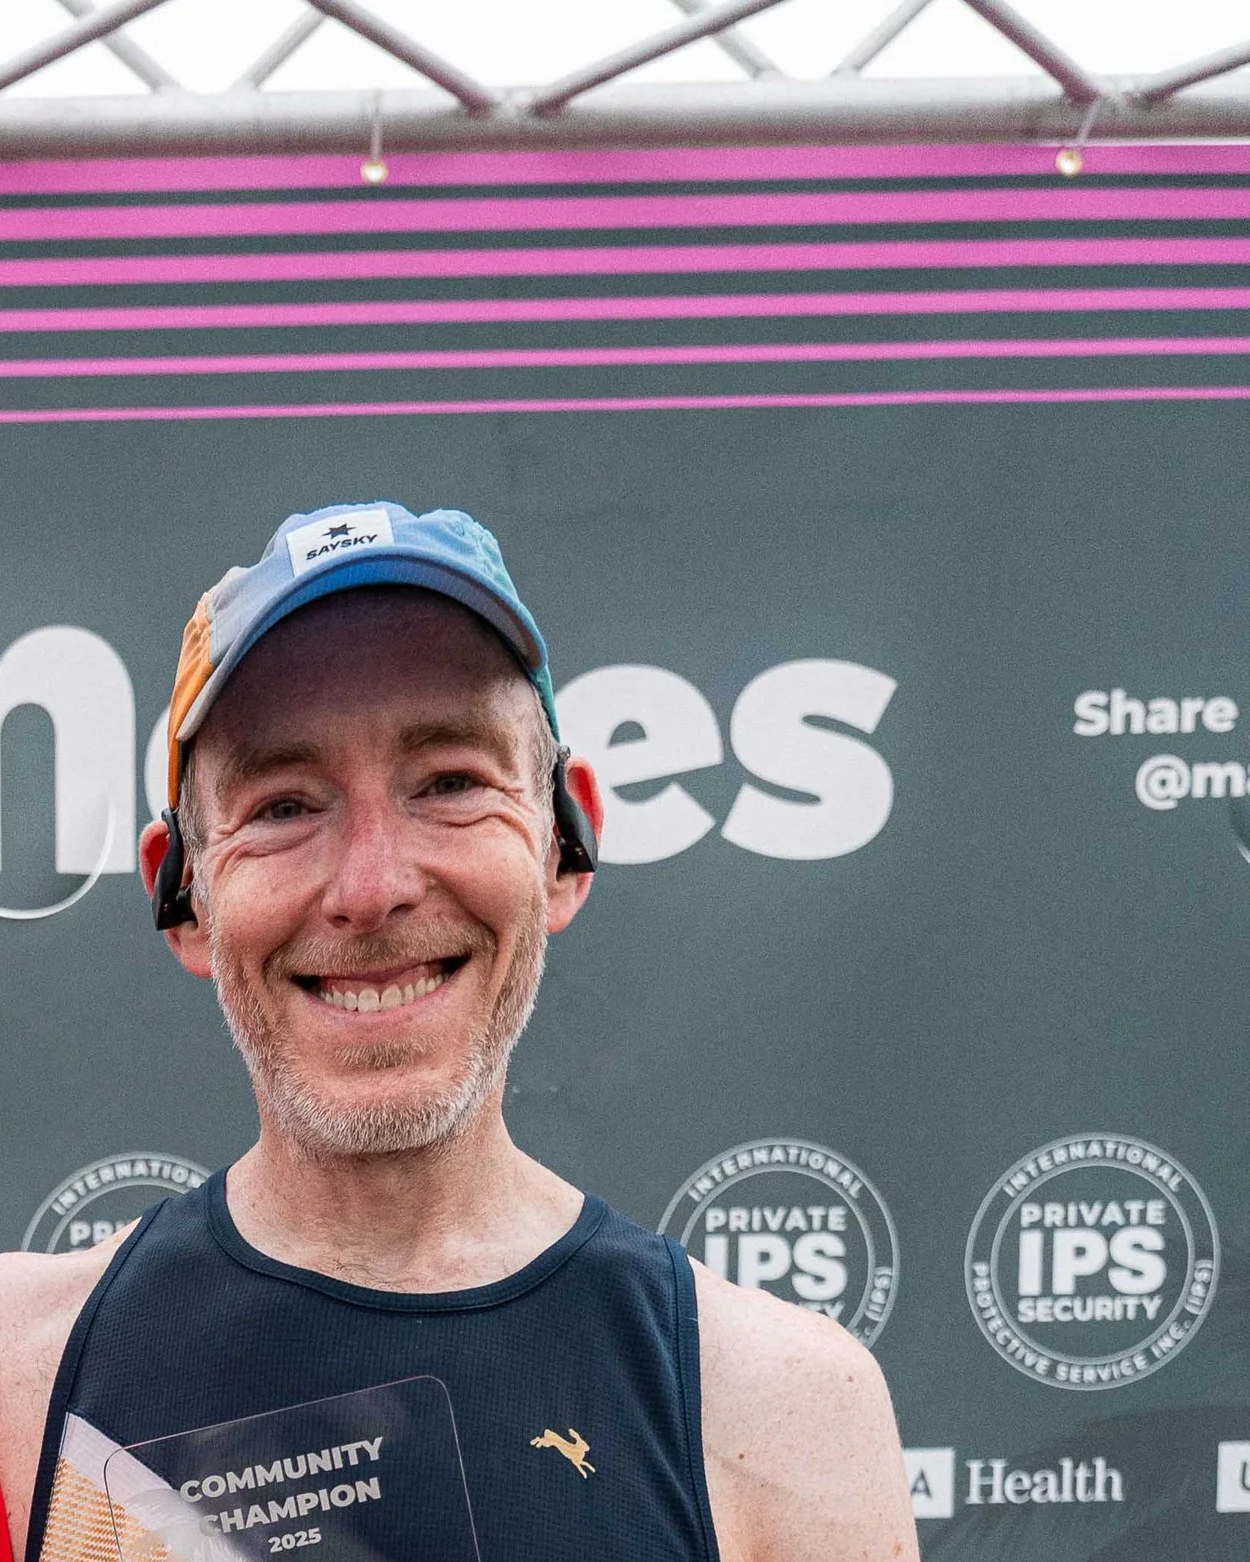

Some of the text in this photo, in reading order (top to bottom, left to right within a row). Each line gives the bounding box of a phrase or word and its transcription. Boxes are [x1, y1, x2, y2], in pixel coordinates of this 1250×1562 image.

[306, 533, 378, 561] SAYSKY
[1073, 690, 1237, 737] Share
[687, 1146, 863, 1202] INTERNATIONAL
[1002, 1141, 1184, 1197] INTERNATIONAL
[705, 1206, 847, 1232] PRIVATE
[1020, 1200, 1167, 1228] PRIVATE
[704, 1232, 848, 1301] IPS
[1018, 1226, 1167, 1296] IPS
[972, 1261, 1050, 1376] PROTECTIVE
[1055, 1351, 1149, 1384] SERVICE
[1017, 1296, 1163, 1323] SECURITY
[180, 1437, 383, 1504] COMMUNITY
[965, 1457, 1125, 1505] Health
[199, 1477, 382, 1537] CHAMPION
[268, 1528, 322, 1554] 2025
